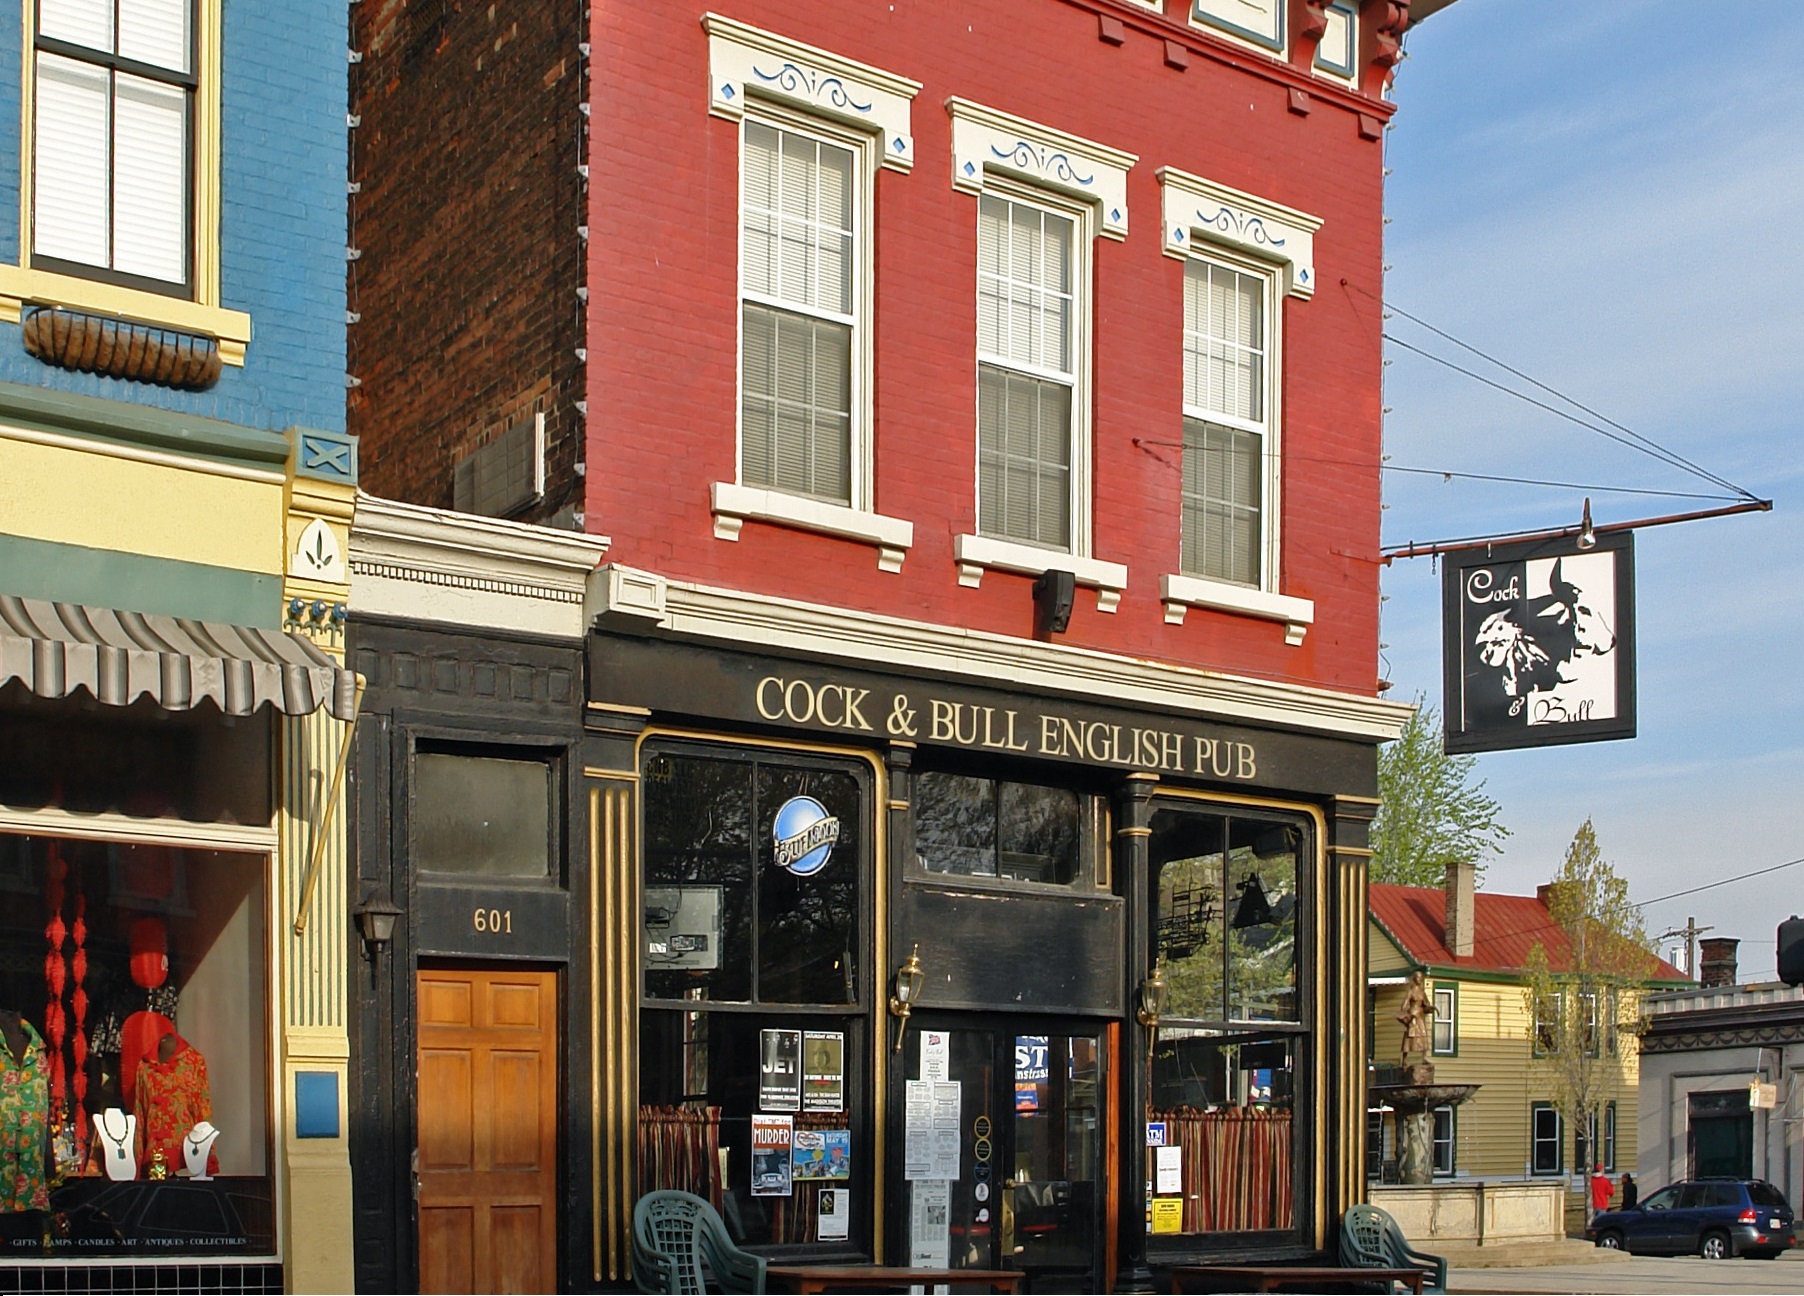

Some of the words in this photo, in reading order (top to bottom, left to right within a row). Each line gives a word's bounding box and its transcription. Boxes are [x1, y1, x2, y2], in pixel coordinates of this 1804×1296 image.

[1467, 569, 1520, 603] Cock
[1532, 696, 1594, 726] Bull
[756, 676, 874, 732] COCK
[886, 694, 918, 737] &
[929, 699, 1029, 752] BULL
[1038, 715, 1185, 772] ENGLISH
[1193, 736, 1257, 780] PUB
[474, 908, 512, 933] 601
[762, 1058, 796, 1074] JET
[753, 1128, 790, 1145] MURDER
[12, 1238, 38, 1247] GIFTS
[78, 1238, 116, 1247] CANDLES
[120, 1238, 137, 1247] ART
[145, 1238, 184, 1247] ANTIQUES
[189, 1238, 247, 1246] COLLECTIBLES
